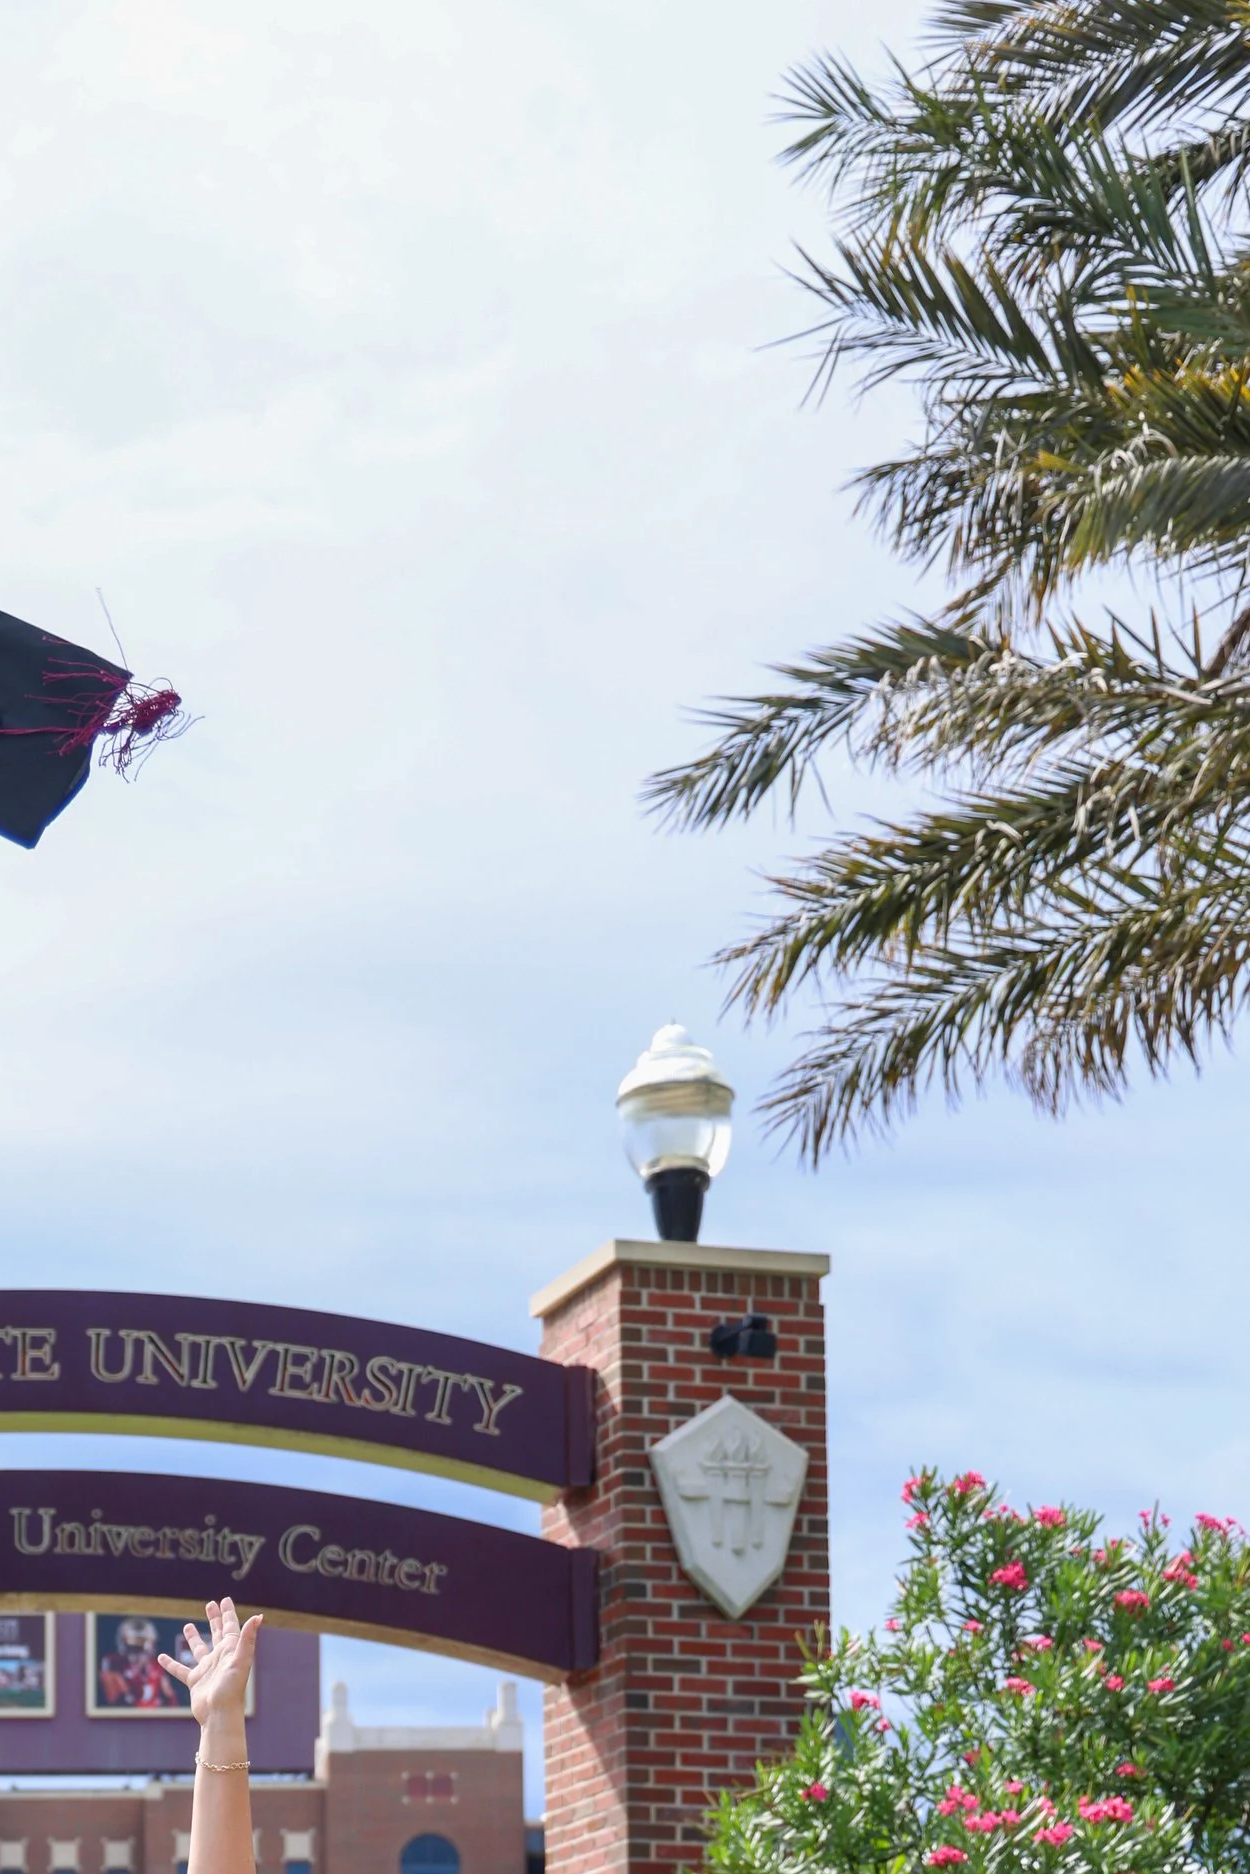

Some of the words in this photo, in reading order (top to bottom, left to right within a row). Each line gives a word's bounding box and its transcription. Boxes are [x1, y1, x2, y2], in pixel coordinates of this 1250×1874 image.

[86, 1328, 523, 1436] UNIVERSITY
[10, 1507, 265, 1580] University
[279, 1525, 447, 1594] Center
